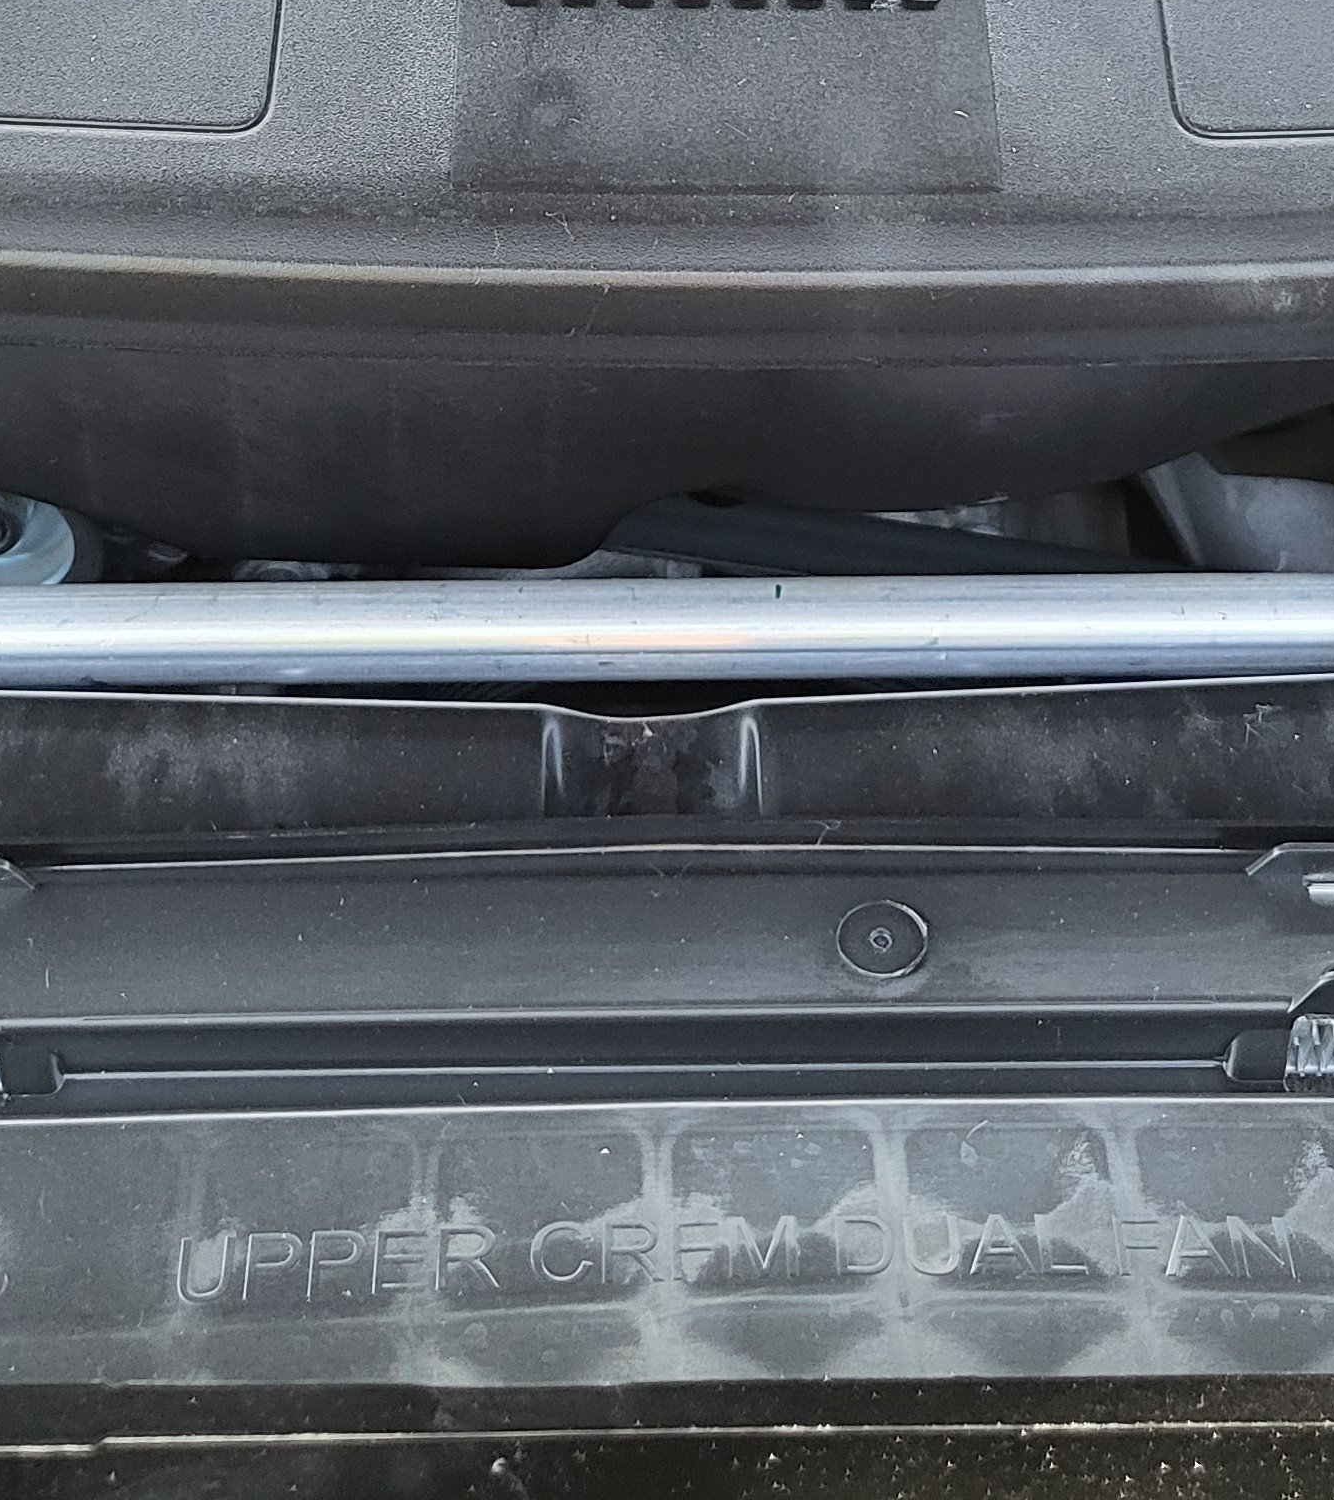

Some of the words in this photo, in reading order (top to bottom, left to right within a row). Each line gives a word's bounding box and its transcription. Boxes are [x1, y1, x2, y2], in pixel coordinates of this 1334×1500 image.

[175, 1222, 501, 1302] UPPER
[834, 1212, 1089, 1279] DUAL
[1111, 1213, 1302, 1283] FAN
